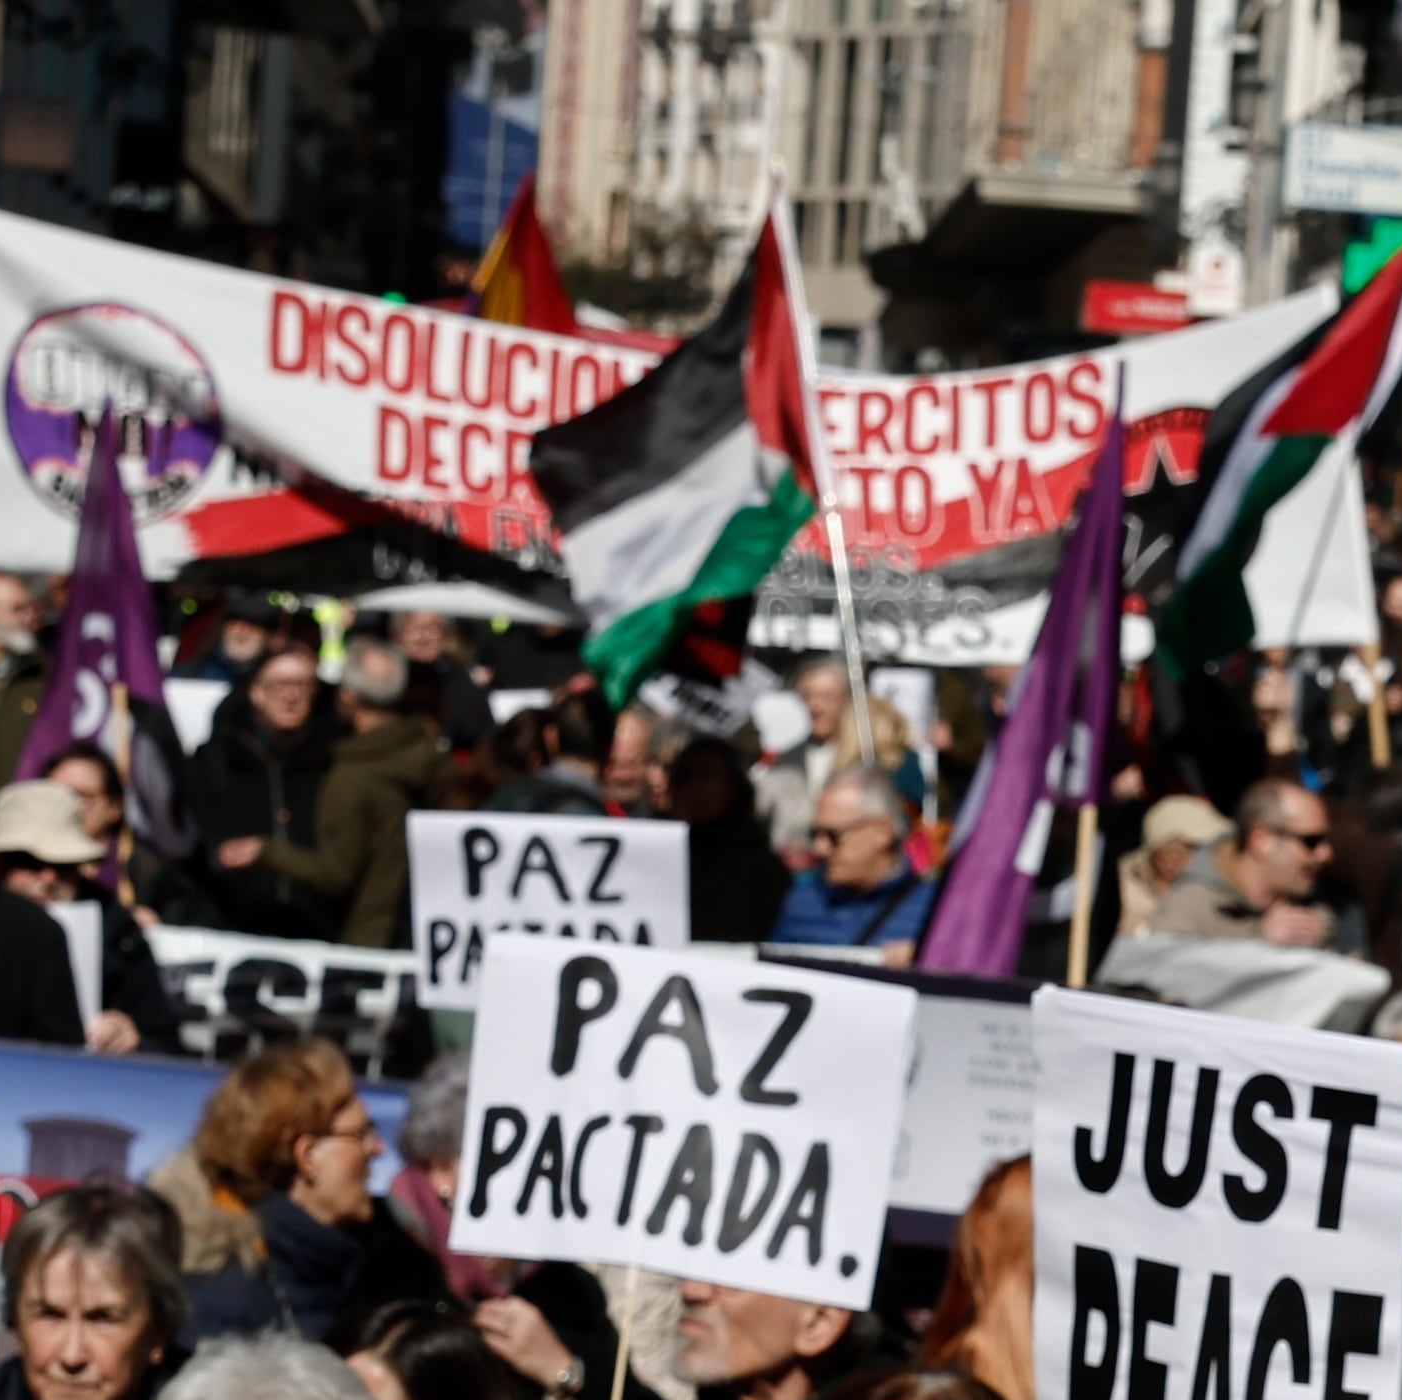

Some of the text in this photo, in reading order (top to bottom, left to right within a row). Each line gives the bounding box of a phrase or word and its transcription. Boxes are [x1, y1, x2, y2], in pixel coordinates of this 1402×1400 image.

[970, 458, 1047, 533] YA
[462, 827, 625, 904] PAZ
[550, 955, 815, 1108] PAZ
[469, 1106, 860, 1277] PACTADA.
[1074, 1053, 1379, 1231] JUST
